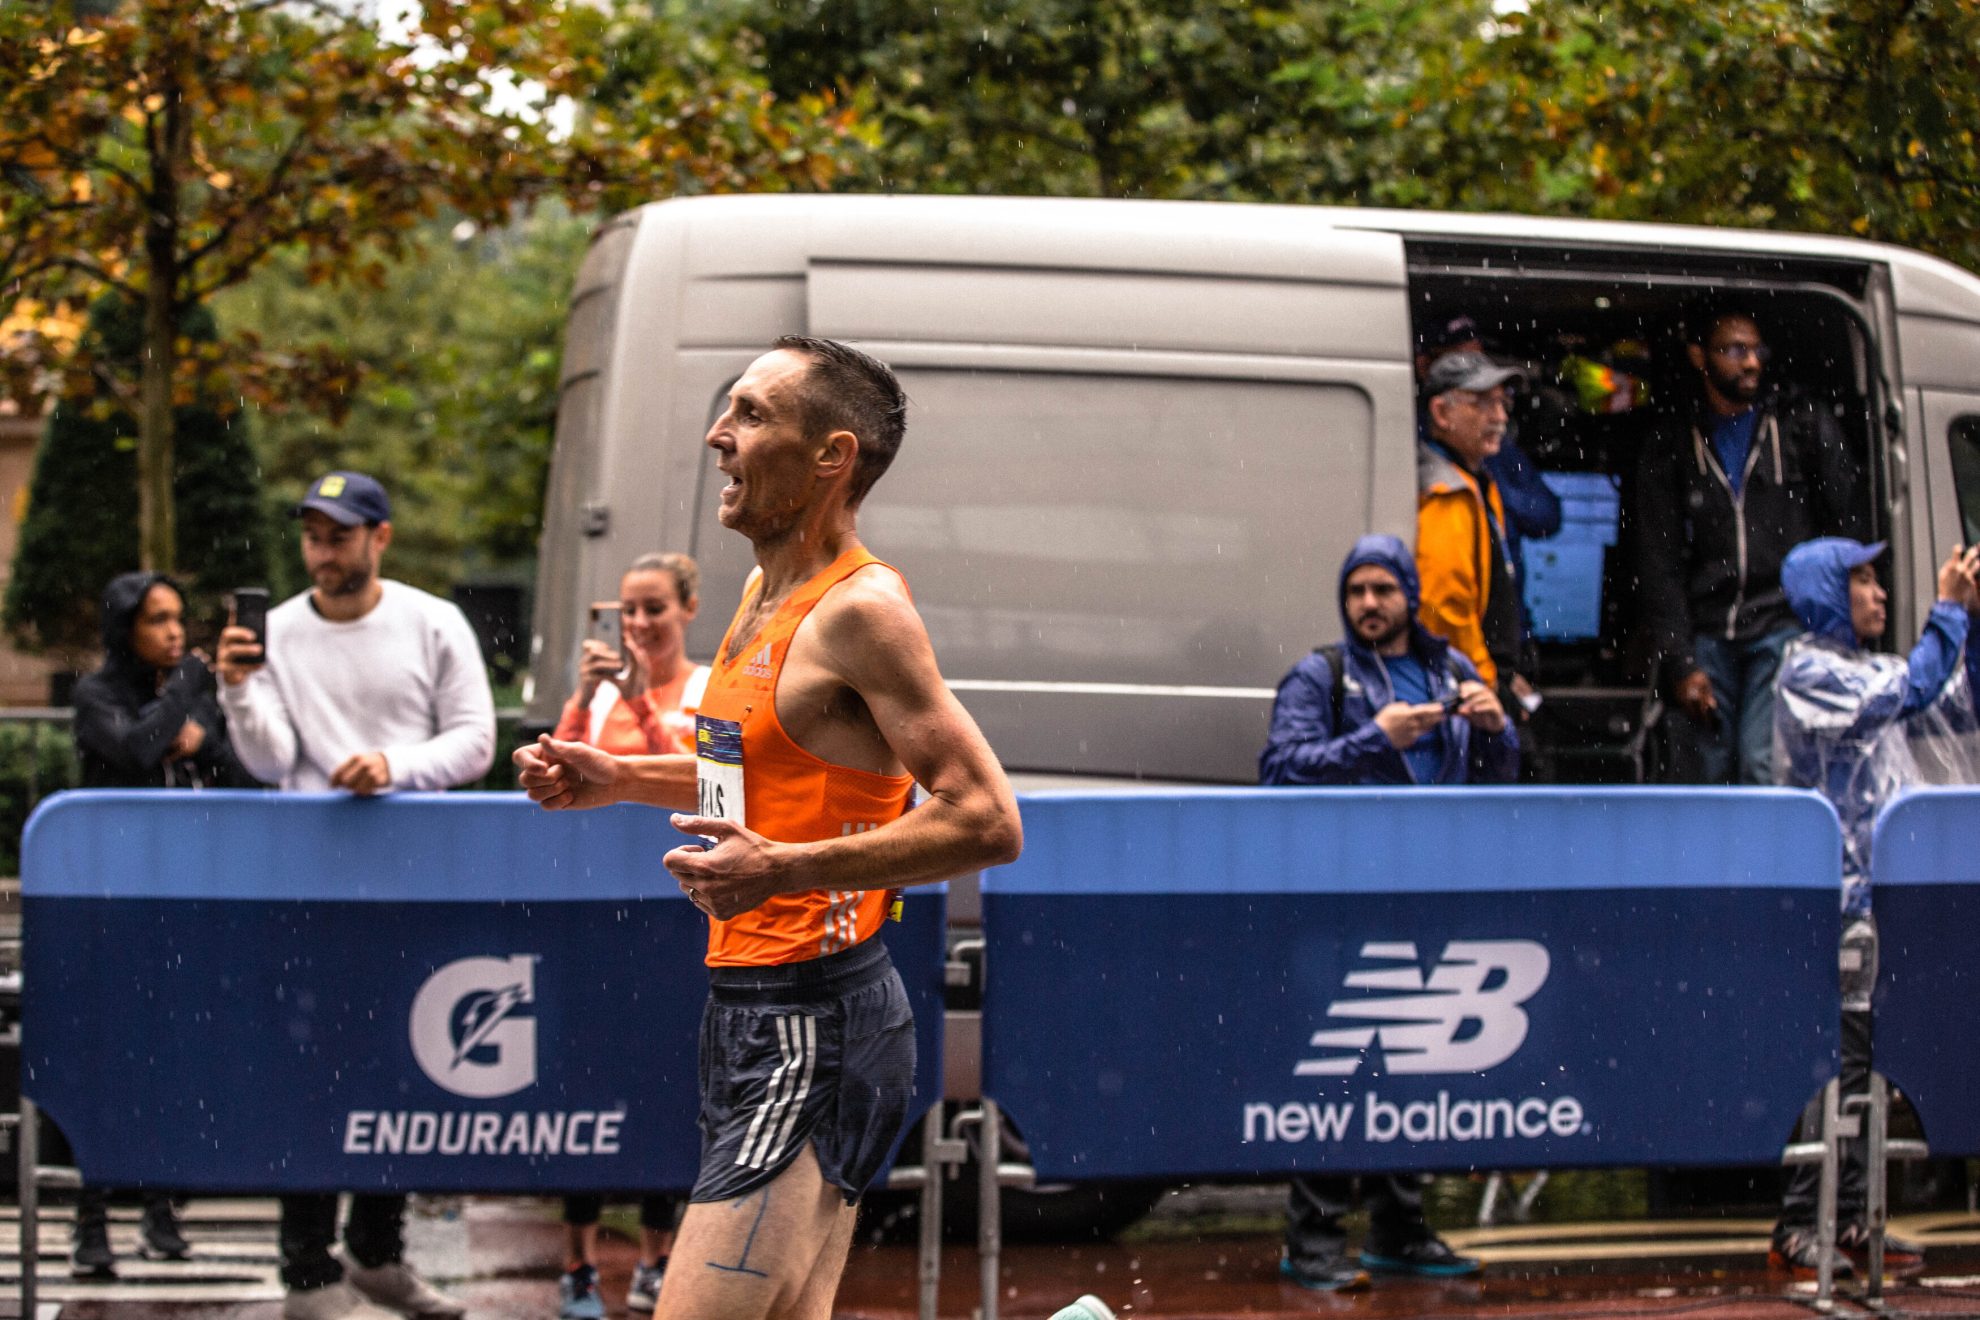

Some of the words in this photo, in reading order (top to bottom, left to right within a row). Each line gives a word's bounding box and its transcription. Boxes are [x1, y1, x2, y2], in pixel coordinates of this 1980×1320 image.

[343, 1110, 626, 1155] ENDURANCE
[1243, 1102, 1354, 1142] new
[1365, 1090, 1583, 1142] balance
